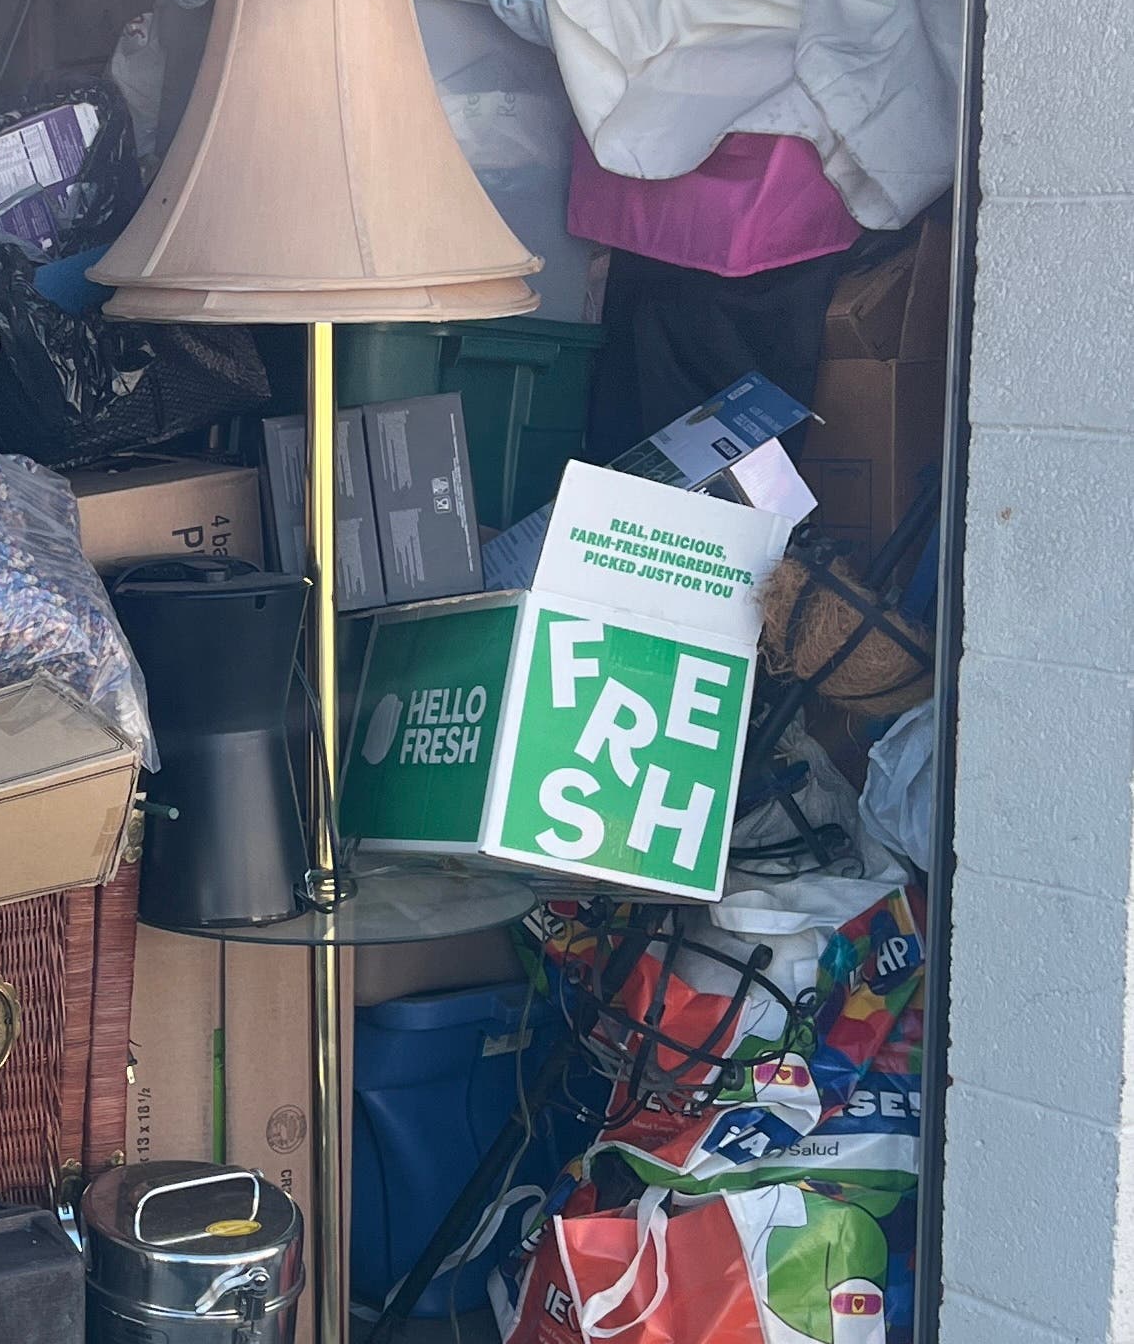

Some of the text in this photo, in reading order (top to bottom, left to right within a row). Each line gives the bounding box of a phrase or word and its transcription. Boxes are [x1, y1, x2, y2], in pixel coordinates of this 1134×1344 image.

[211, 515, 230, 527] 4
[609, 518, 727, 562] REAL, DELICIOUS,
[569, 527, 659, 561] FARM-FRESH
[659, 549, 755, 586] INGREDIENTS.
[583, 550, 734, 599] PICKED JUST FOR YOU
[406, 685, 487, 725] HELLO
[399, 726, 482, 765] FRESH
[833, 1090, 921, 1118] SE!
[789, 1141, 839, 1157] Salud
